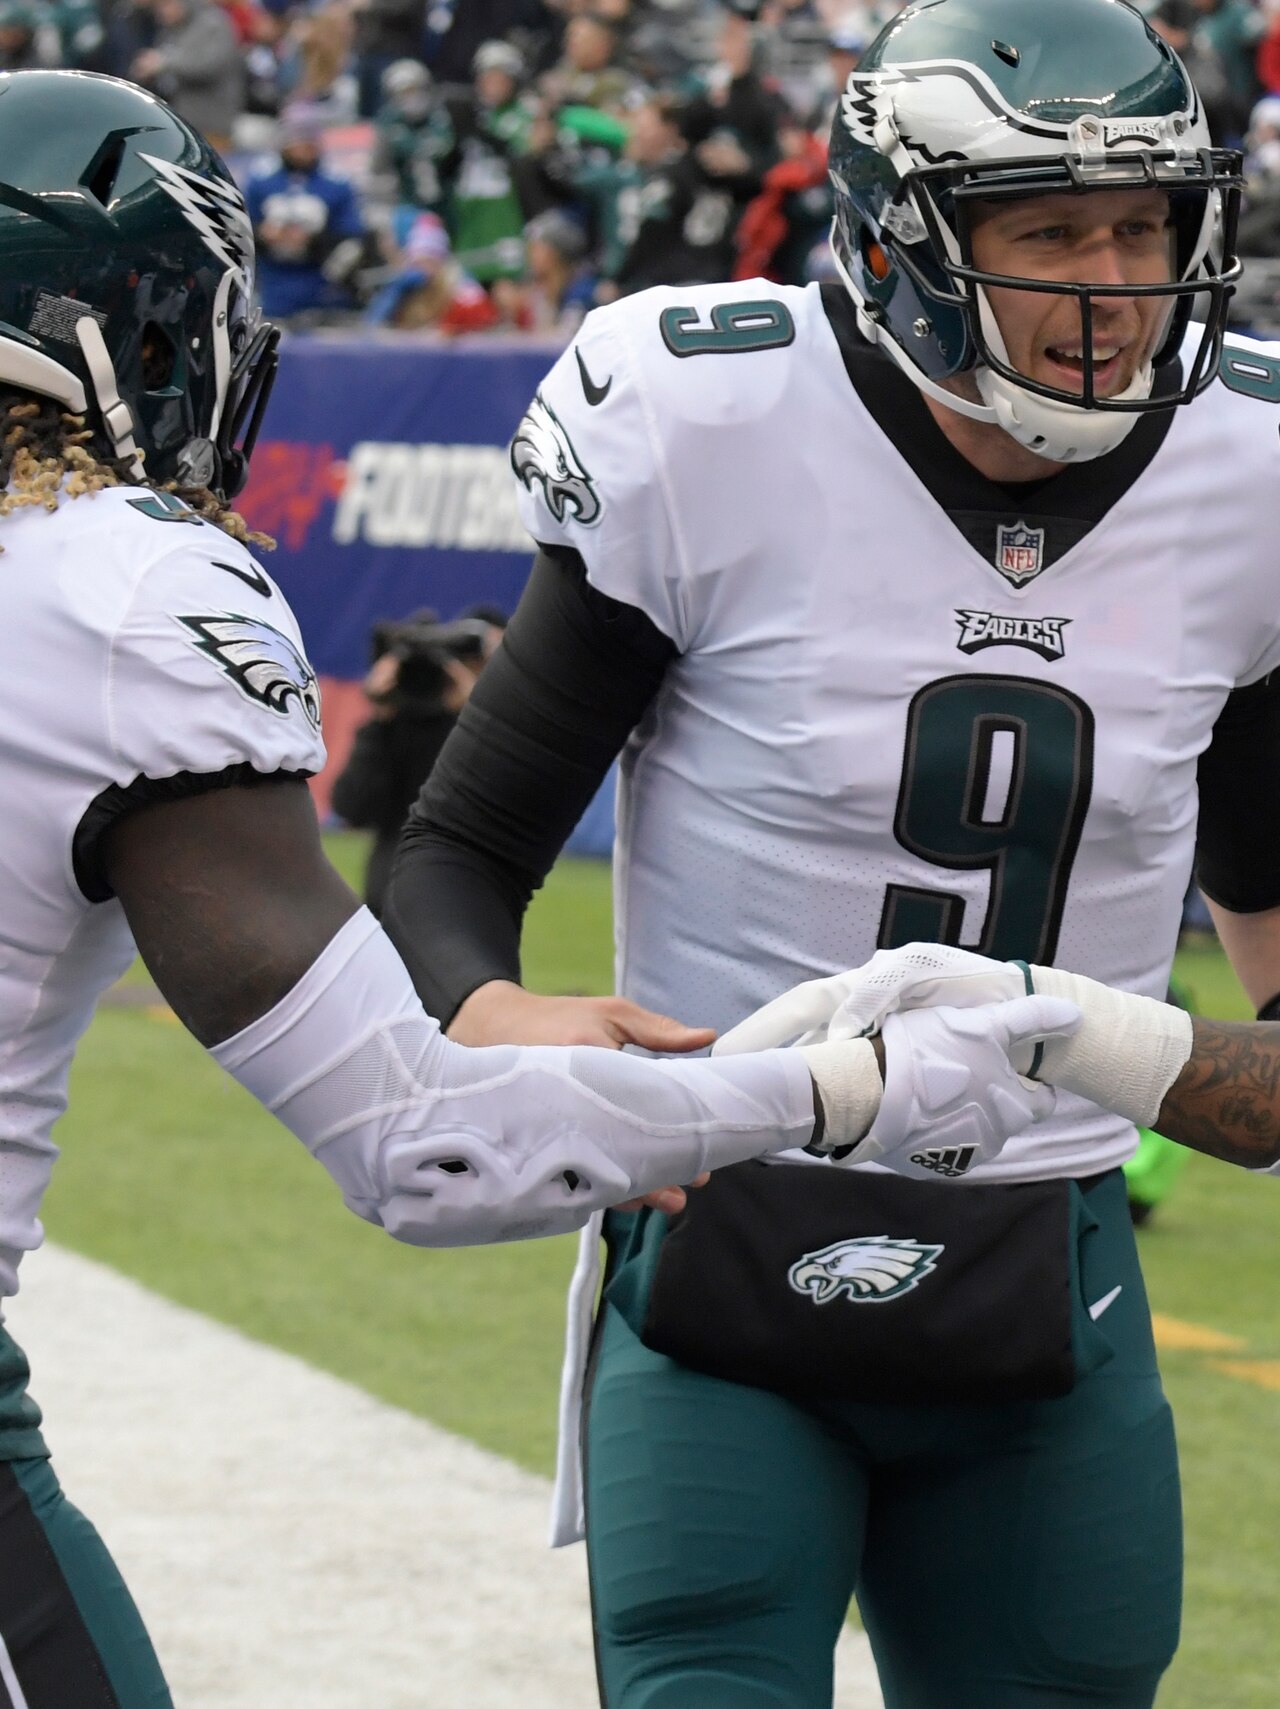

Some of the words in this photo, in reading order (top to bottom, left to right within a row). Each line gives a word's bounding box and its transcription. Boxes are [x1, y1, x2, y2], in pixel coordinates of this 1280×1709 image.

[1103, 122, 1162, 148] EAGLES
[659, 299, 796, 358] 9
[1003, 547, 1035, 571] NFL
[953, 608, 1074, 662] EAGLES
[877, 673, 1095, 968] 9
